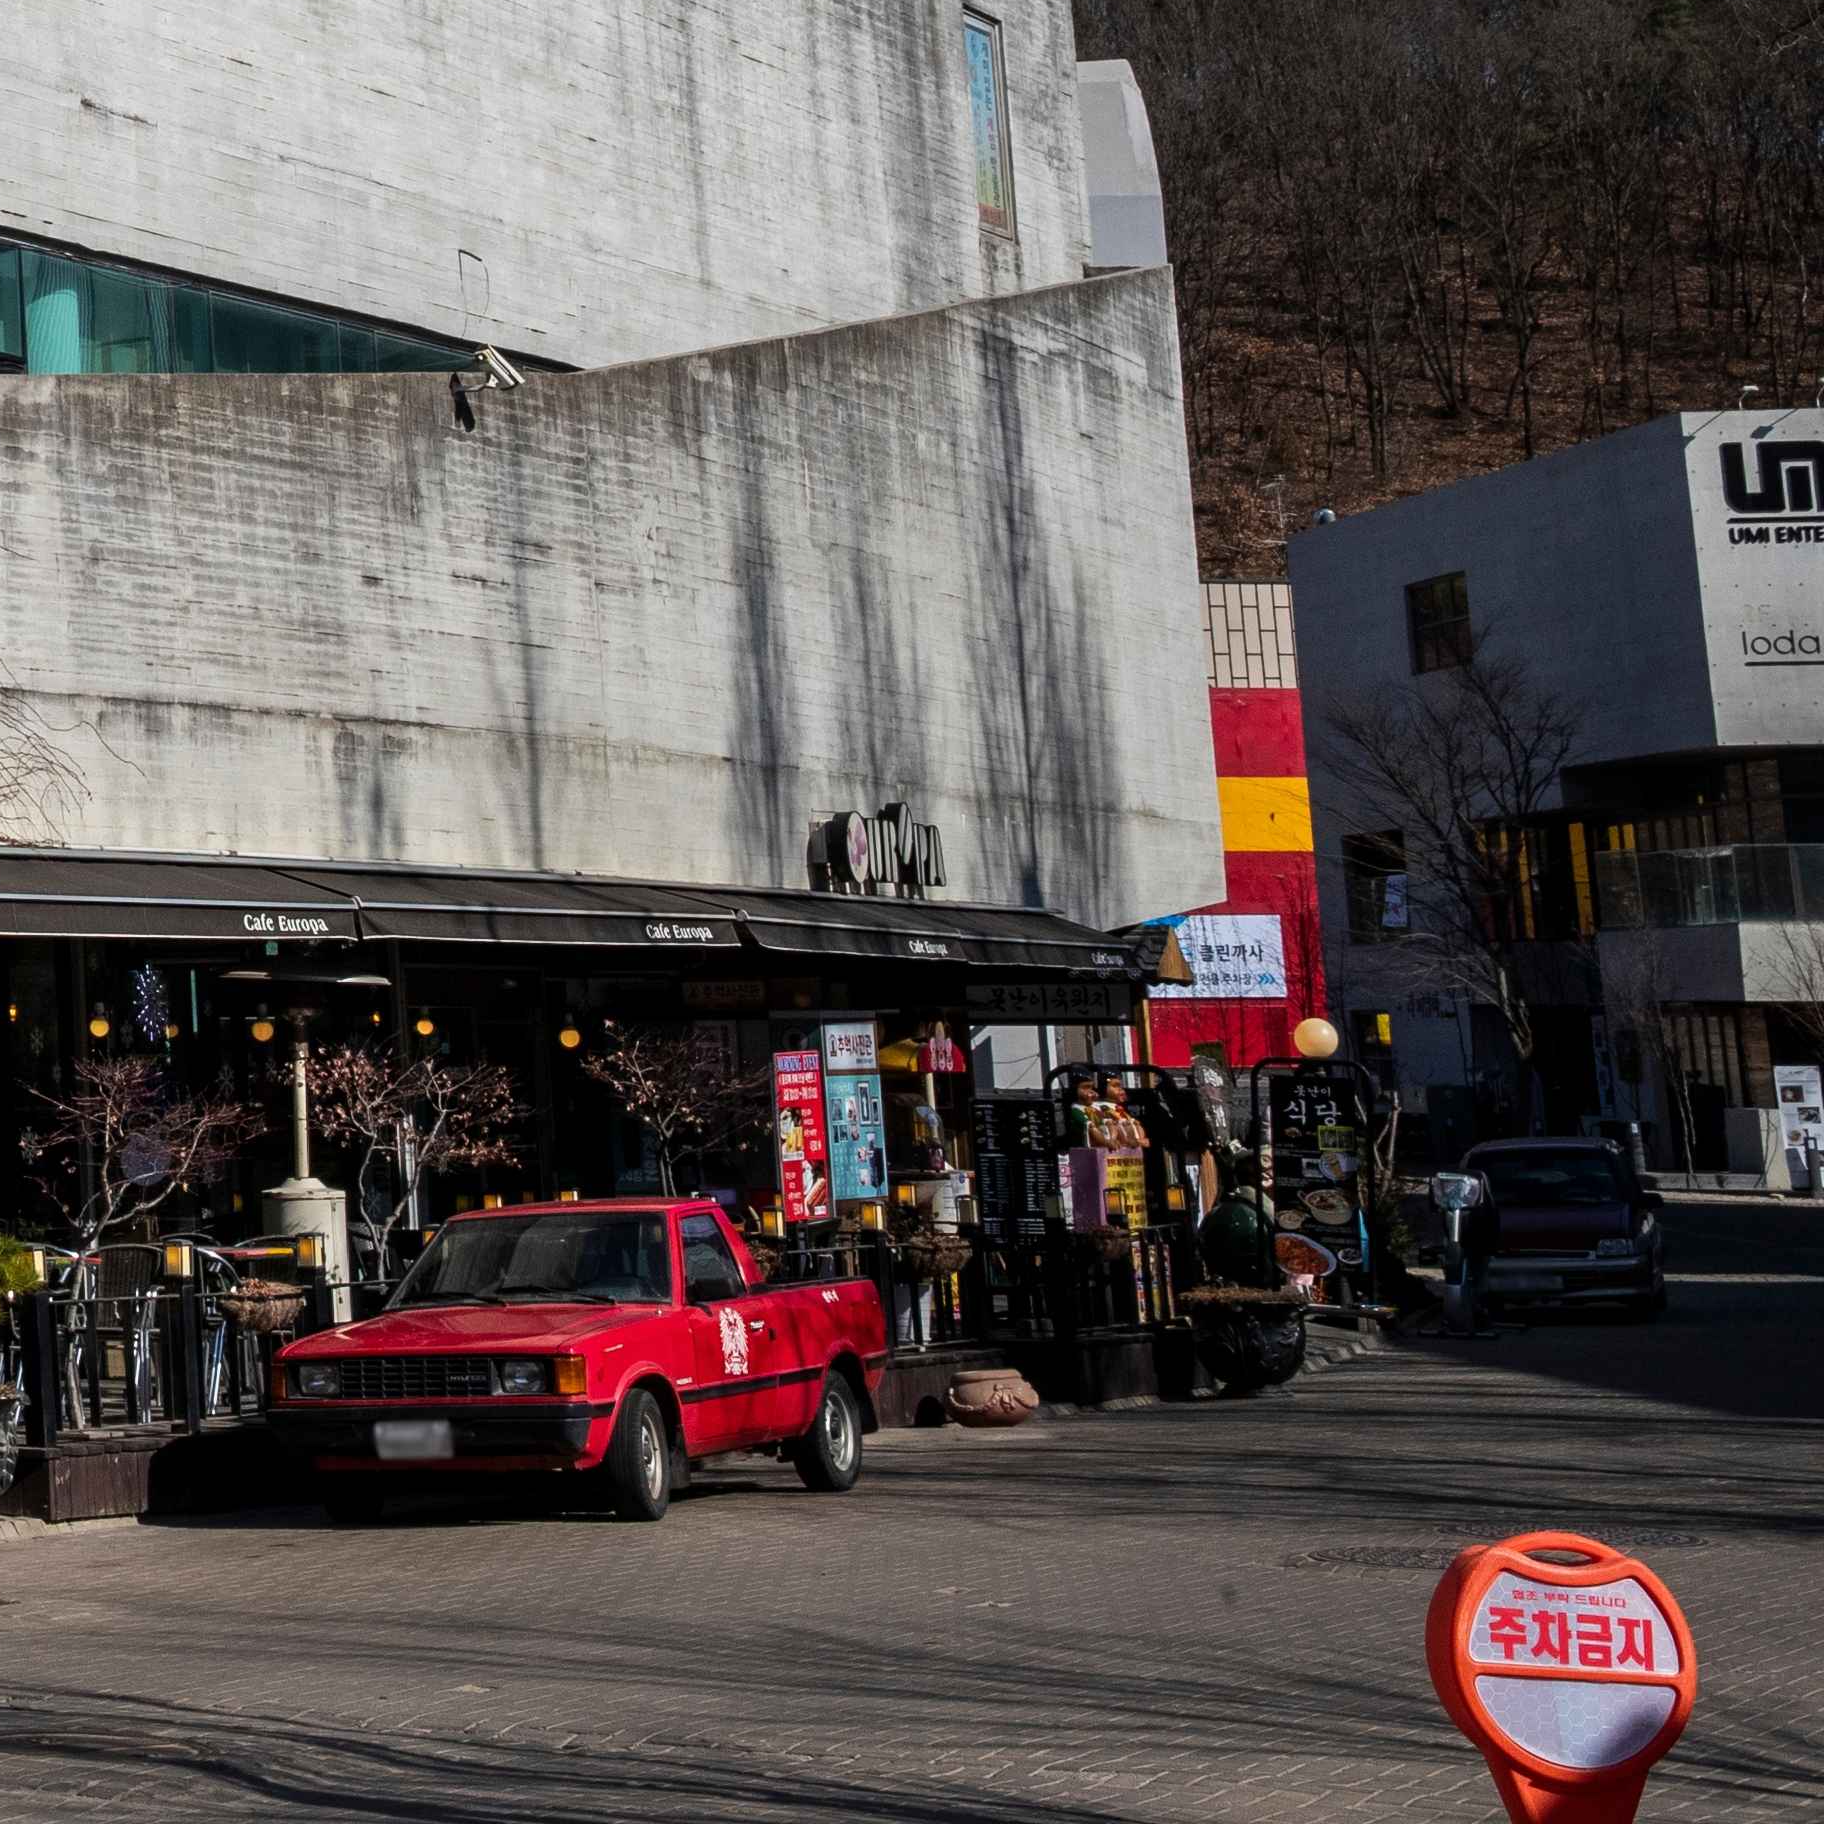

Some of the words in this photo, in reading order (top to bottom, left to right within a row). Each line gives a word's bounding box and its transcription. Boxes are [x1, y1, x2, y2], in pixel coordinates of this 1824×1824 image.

[1728, 527, 1770, 545] UMI
[244, 913, 275, 933] Cafe
[277, 914, 329, 936] Europa
[646, 923, 671, 942] Cafe
[673, 924, 713, 944] Europa
[1200, 943, 1265, 965] 클린까사
[1283, 1098, 1342, 1127] 식당
[1512, 1589, 1538, 1602] 협조
[1544, 1591, 1569, 1604] 부탁
[1575, 1592, 1628, 1609] 드립니다
[1488, 1605, 1656, 1673] 주차금지
